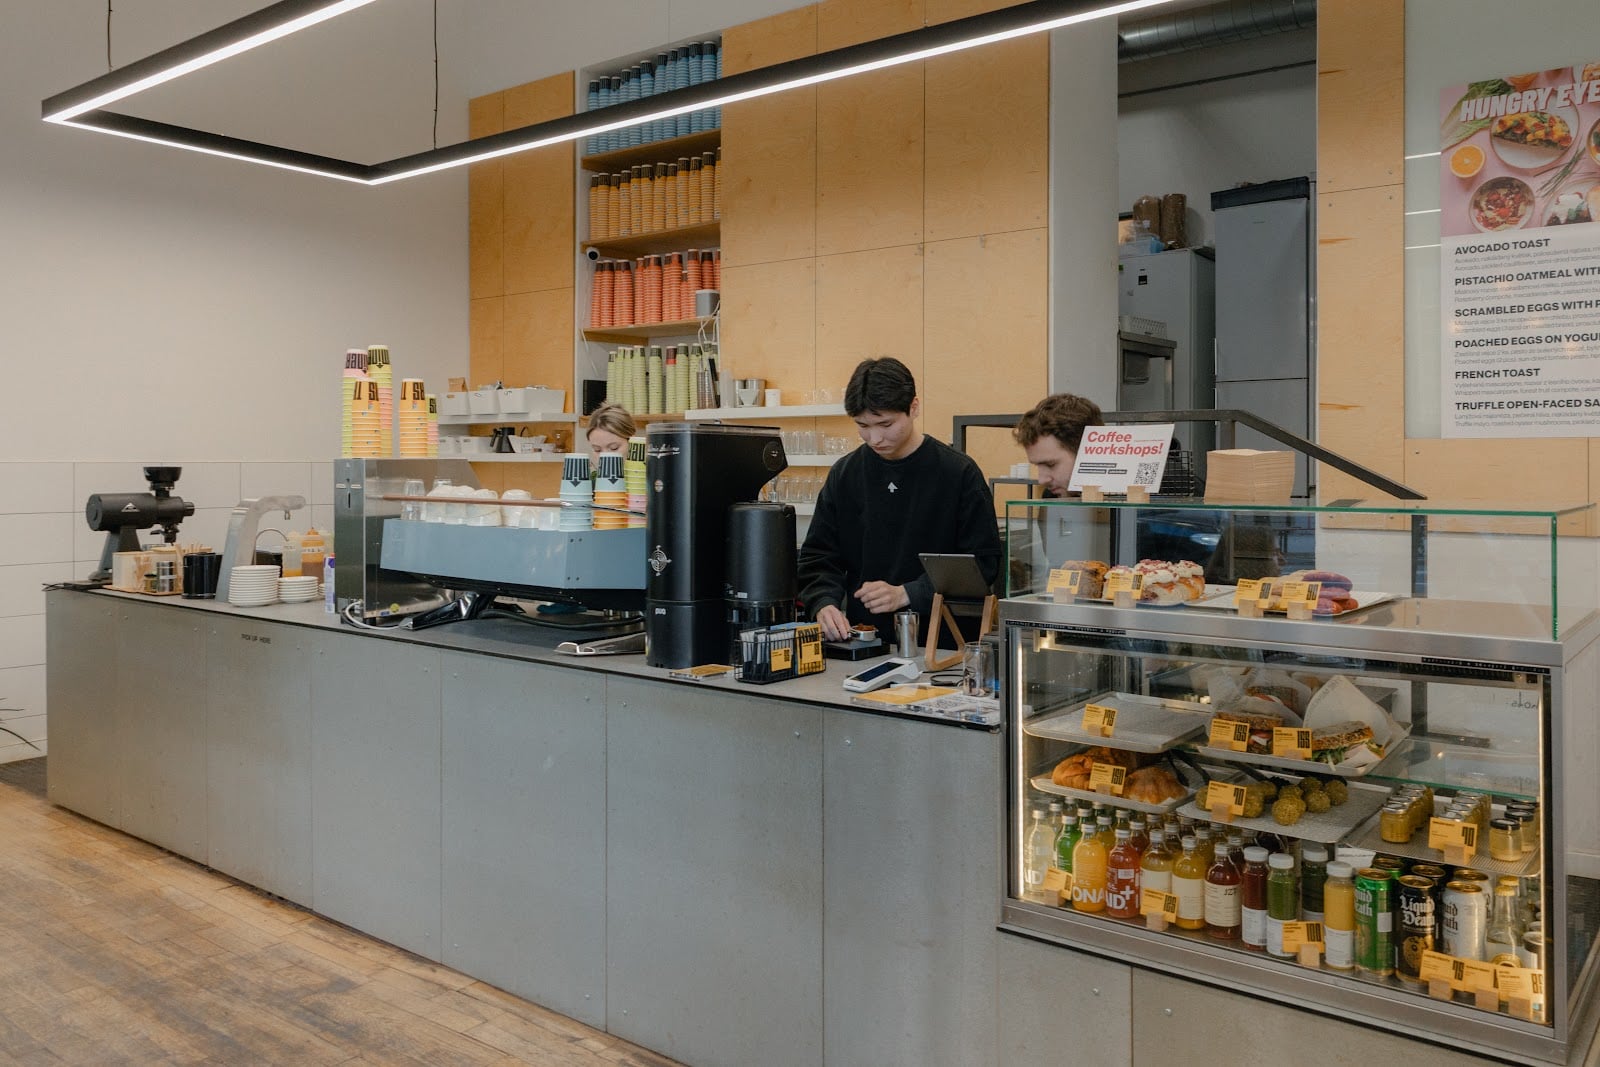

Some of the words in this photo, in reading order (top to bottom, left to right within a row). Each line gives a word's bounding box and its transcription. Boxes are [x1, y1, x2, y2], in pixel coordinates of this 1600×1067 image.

[1460, 86, 1552, 122] HUNGRY
[1455, 242, 1510, 254] AVOCADO
[1512, 238, 1550, 250] TOAST
[1455, 274, 1514, 286] PISTACHIO
[1516, 269, 1572, 282] OATMEAL
[1455, 305, 1525, 317] SCRAMBLED
[1528, 302, 1559, 313] EGGS
[1562, 300, 1592, 310] WITH
[1455, 338, 1509, 348] POACHED
[1512, 336, 1542, 345] EGGS
[1545, 334, 1562, 344] ON
[1455, 370, 1500, 379] FRENCH
[1502, 368, 1540, 377] TOAST
[1456, 402, 1504, 410] TRUFFLE
[1506, 400, 1582, 409] OPEN-FACED
[1088, 431, 1132, 442] Coffee
[1084, 443, 1164, 457] workshops!
